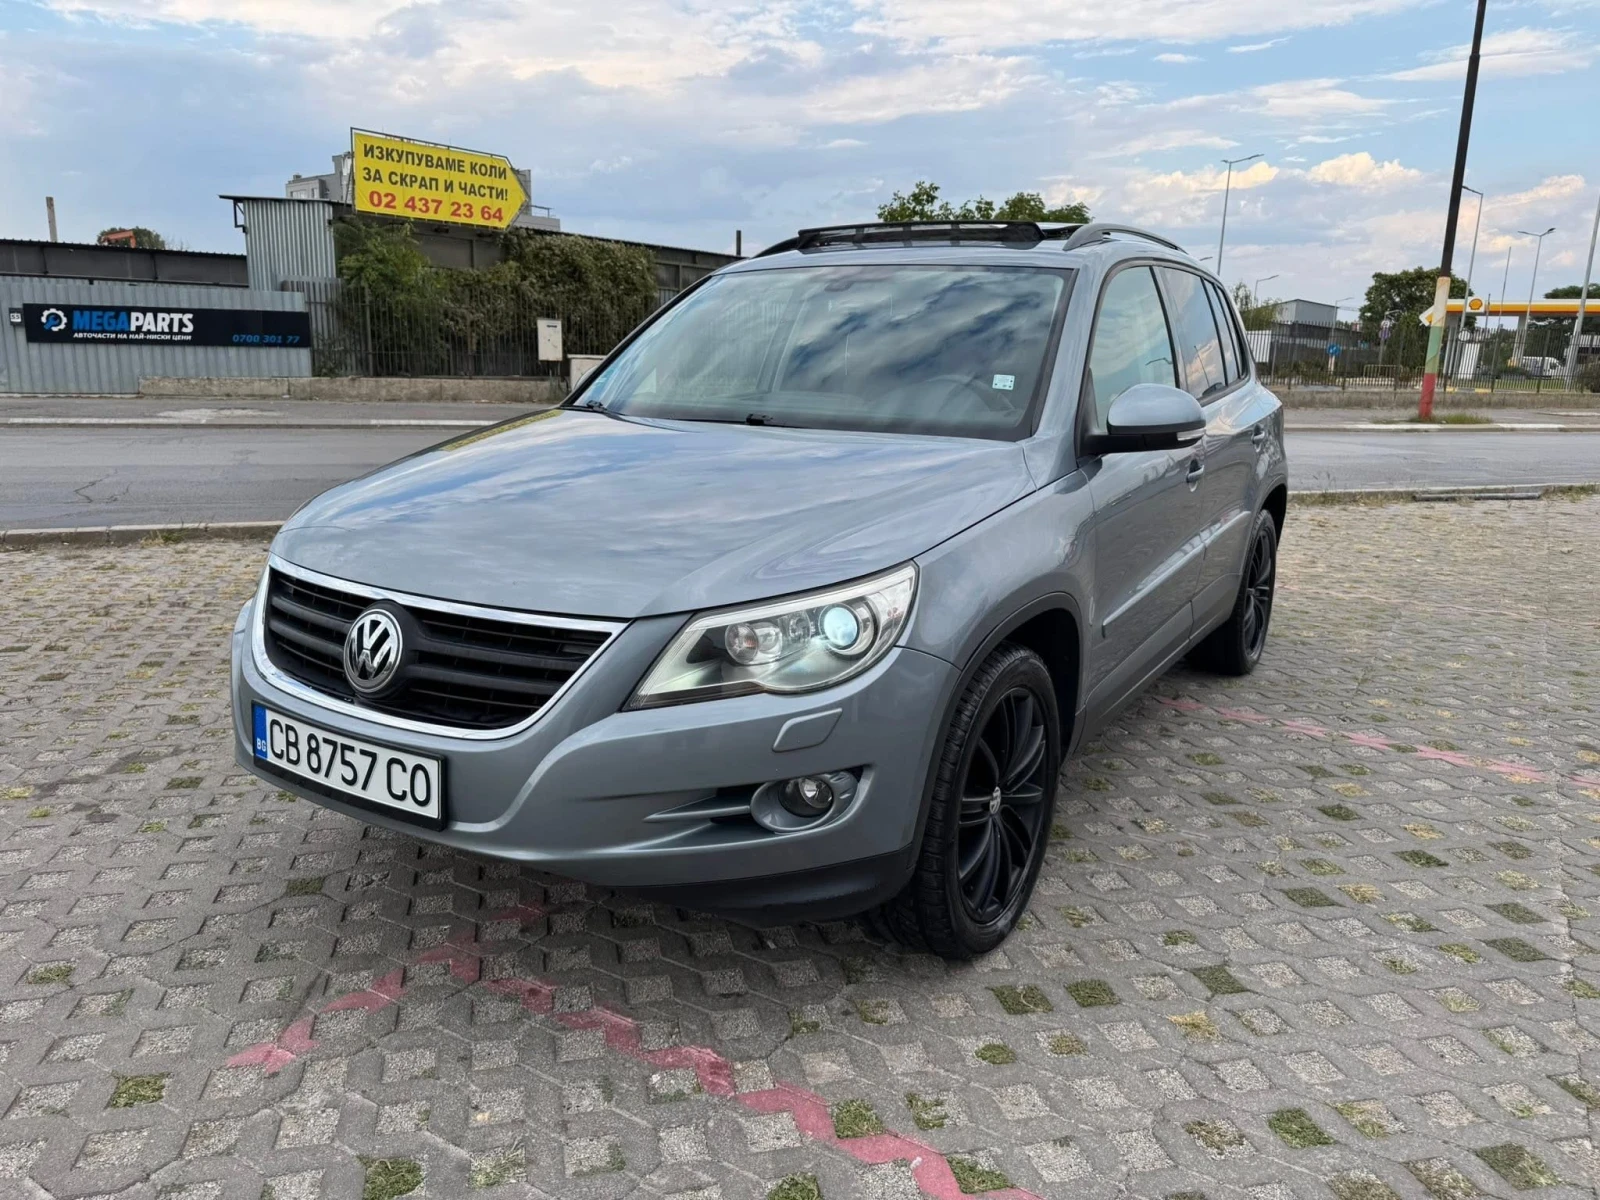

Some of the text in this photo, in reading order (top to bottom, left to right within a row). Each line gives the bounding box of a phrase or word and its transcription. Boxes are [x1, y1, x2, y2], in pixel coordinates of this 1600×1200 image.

[363, 143, 507, 180] ИЗКУПУВАМЕ КОЛИ
[363, 167, 508, 201] ЗА СКРАП И ЧАСТИ!
[369, 190, 504, 222] 02 437 23 64
[129, 333, 171, 341] НАЙ-НИСКИ
[232, 334, 300, 344] 0700 301 77
[256, 738, 267, 753] BG
[270, 719, 300, 766] CB
[307, 733, 378, 792] 8757
